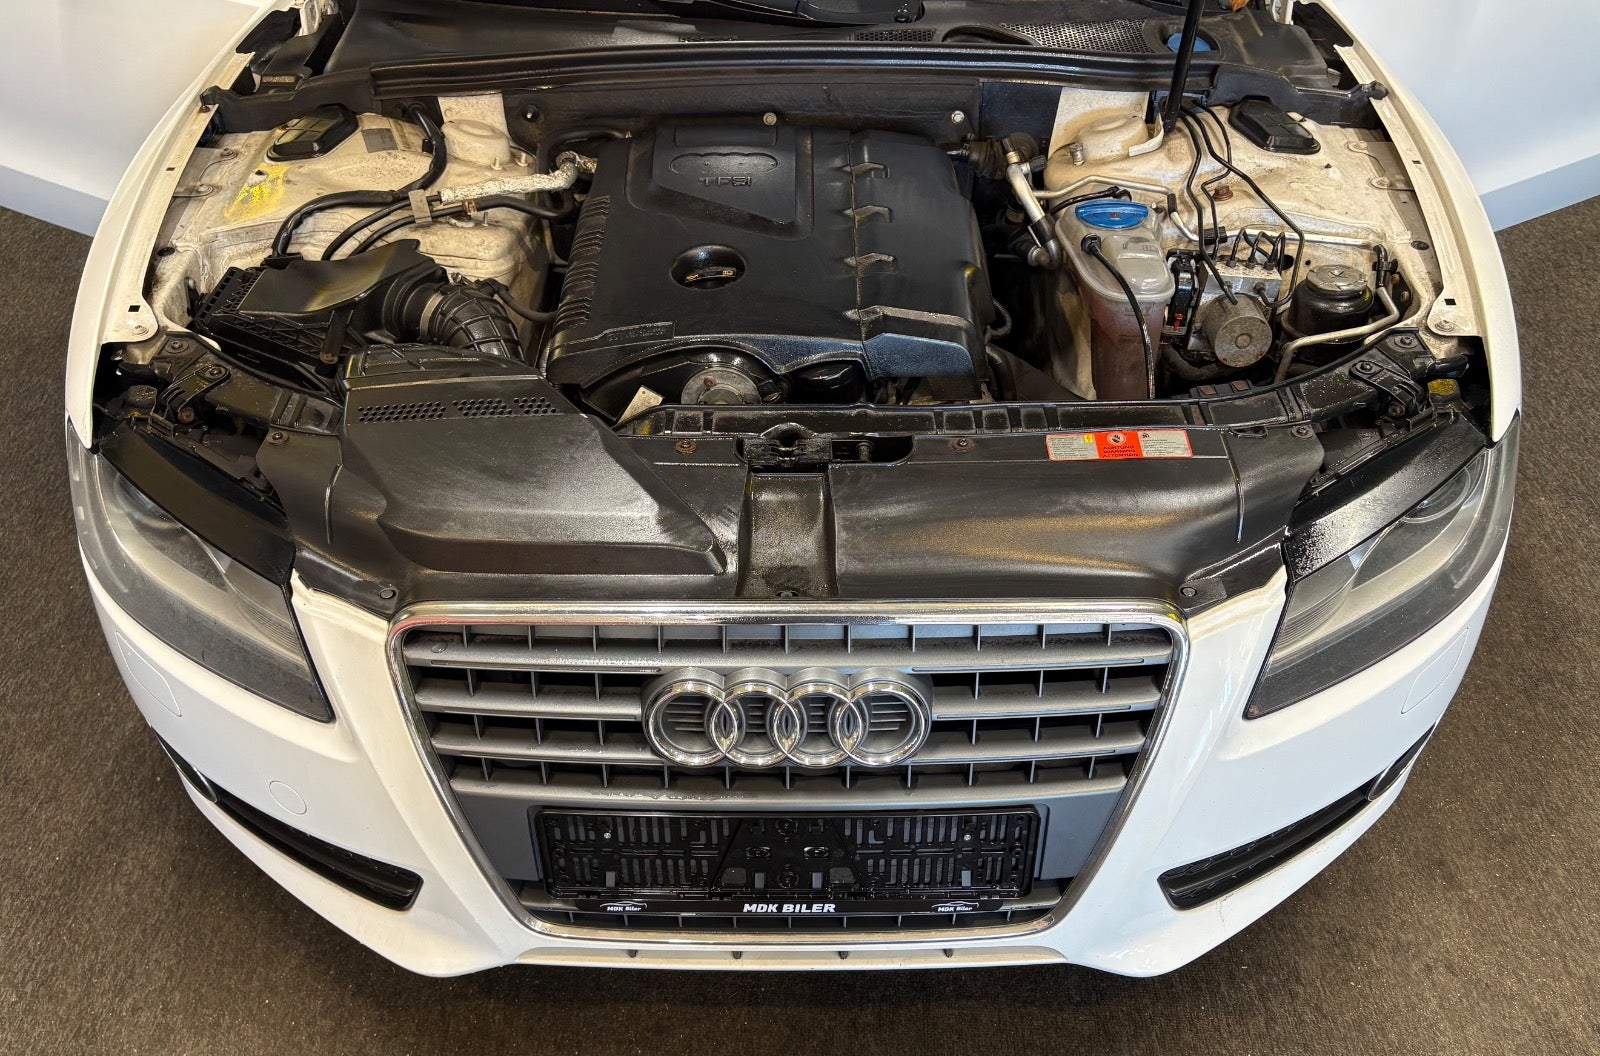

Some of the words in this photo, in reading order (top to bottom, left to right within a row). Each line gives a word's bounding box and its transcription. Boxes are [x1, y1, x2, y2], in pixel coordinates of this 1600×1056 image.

[699, 176, 752, 186] TFSI
[743, 903, 779, 913] MDK
[782, 903, 836, 913] BILER
